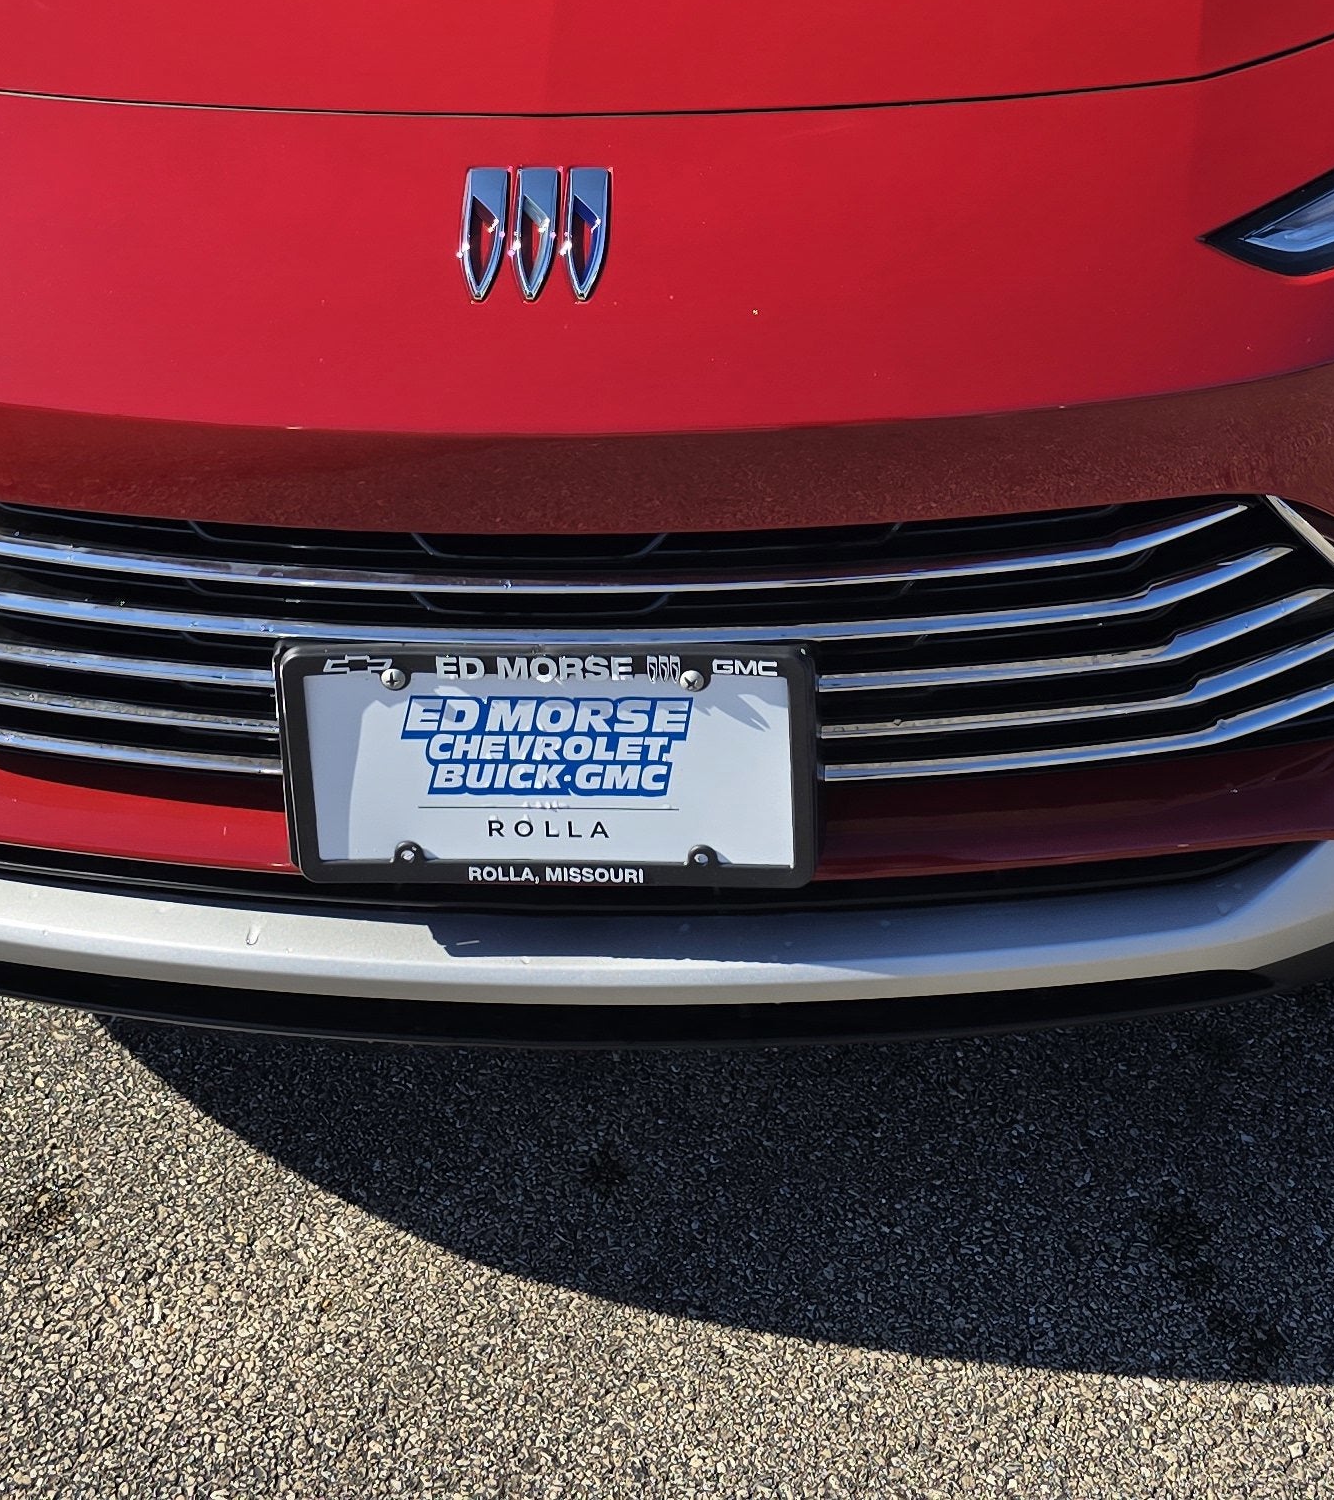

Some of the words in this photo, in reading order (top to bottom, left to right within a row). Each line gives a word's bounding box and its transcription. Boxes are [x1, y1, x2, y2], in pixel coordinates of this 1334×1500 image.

[435, 655, 486, 681] ED
[496, 655, 634, 682] MORSE
[711, 658, 778, 678] GMC
[404, 700, 481, 732] ED
[484, 700, 689, 734] MORSE
[487, 820, 610, 838] ROLLA
[468, 866, 540, 885] ROLLA,
[545, 867, 645, 884] MISSOURI
